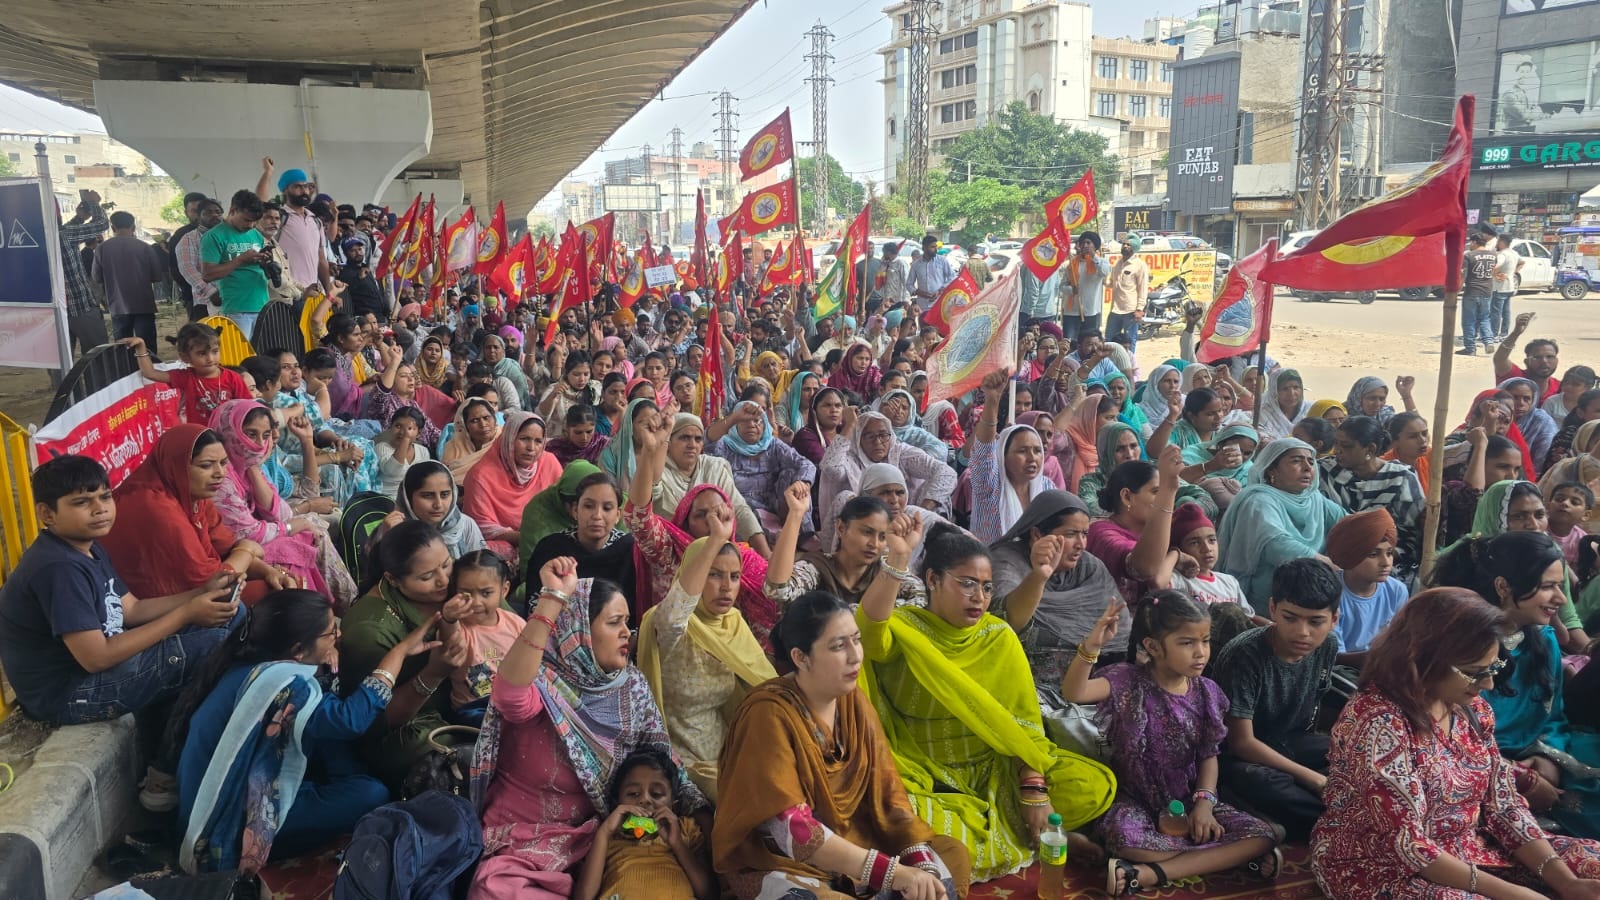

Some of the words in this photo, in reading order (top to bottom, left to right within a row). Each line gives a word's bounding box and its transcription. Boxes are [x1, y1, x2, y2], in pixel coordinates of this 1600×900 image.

[1185, 147, 1214, 162] EAT
[1485, 148, 1509, 161] 999
[1520, 141, 1600, 163] GARG
[1177, 161, 1219, 176] PUNJAB
[1125, 210, 1150, 223] EAT
[1145, 253, 1180, 270] ALIVE
